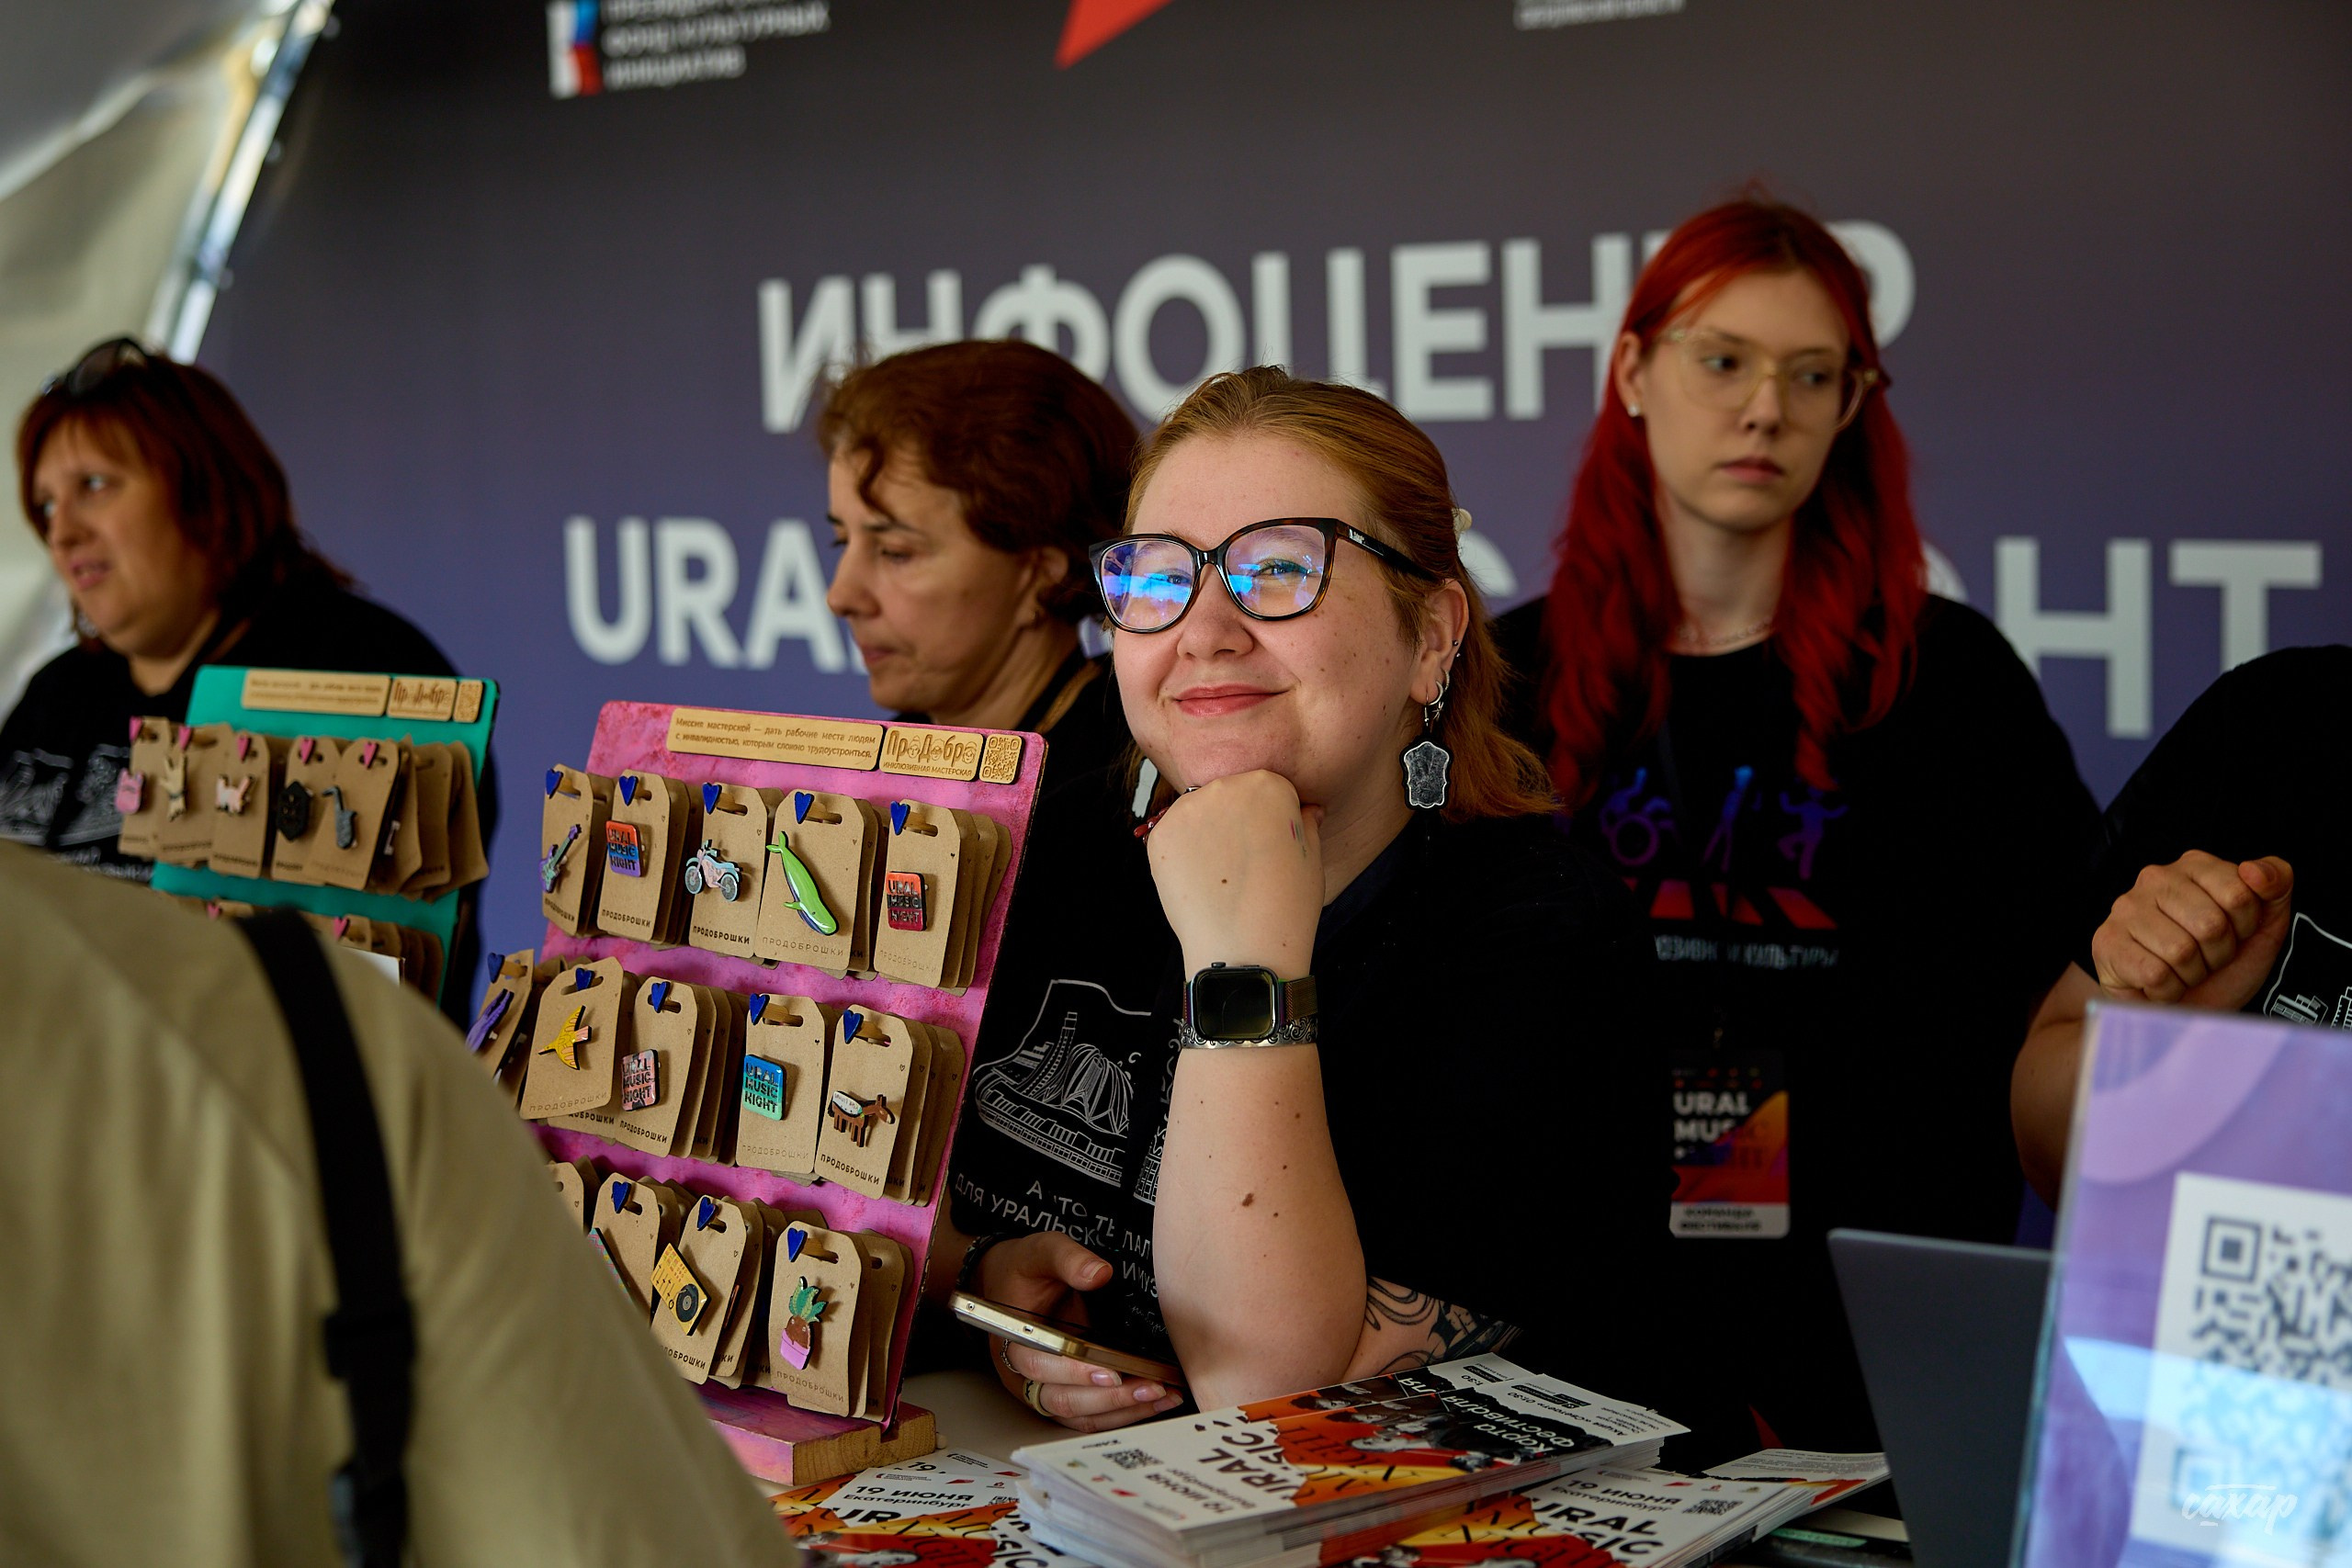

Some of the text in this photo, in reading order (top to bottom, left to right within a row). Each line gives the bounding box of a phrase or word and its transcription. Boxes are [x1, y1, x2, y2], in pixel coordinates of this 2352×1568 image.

[563, 514, 871, 675] URA
[676, 717, 704, 728] Миссия
[707, 722, 751, 733] мастерской
[764, 726, 782, 736] дать
[786, 728, 818, 740] рабочие
[821, 732, 844, 741] места
[848, 734, 876, 744] людям
[742, 739, 775, 750] которым
[776, 742, 805, 751] сложно
[808, 744, 873, 759] трудоустроиться.
[883, 761, 973, 777] ИНКЛЮЗИВНАЯ МАСТЕРСКАЯ
[609, 855, 637, 871] NIGHT
[888, 879, 918, 895] URAL
[602, 908, 650, 928] ПРОДОБРОШКИ
[693, 925, 751, 945] ПРОДОБРОШКИ
[762, 936, 844, 957] ПРОДОБРОШКИ
[623, 1072, 651, 1089] MUSIC
[745, 1062, 779, 1087] URAL
[744, 1075, 779, 1100] MUSIC
[529, 1091, 607, 1111] ПРОДОБРОШКИ
[744, 1089, 778, 1114] NIGHT
[1671, 1089, 1752, 1116] URAL
[568, 1111, 615, 1125] ДОБРОШКИ
[619, 1120, 668, 1145] ПРОДОБРОШКИ
[742, 1145, 809, 1159] ПРОДОБРОШКИ
[820, 1153, 880, 1185] ПРОДОБРОШКИ
[955, 1172, 985, 1207] ДЛЯ
[1025, 1180, 1044, 1201] А
[1053, 1194, 1088, 1218] ТО
[662, 1346, 707, 1370] ОБРОШКИ
[776, 1370, 844, 1403] ПРОДОБРОШКИ
[1442, 1395, 1576, 1448] Фестиваля
[1474, 1423, 1555, 1454] Карта
[842, 1494, 971, 1508] Екатеринбург
[854, 1485, 975, 1501] 19 ИЮНЯ
[1551, 1485, 1672, 1512] Екатеринбург
[1567, 1480, 1683, 1506] 19 ИЮНЯ
